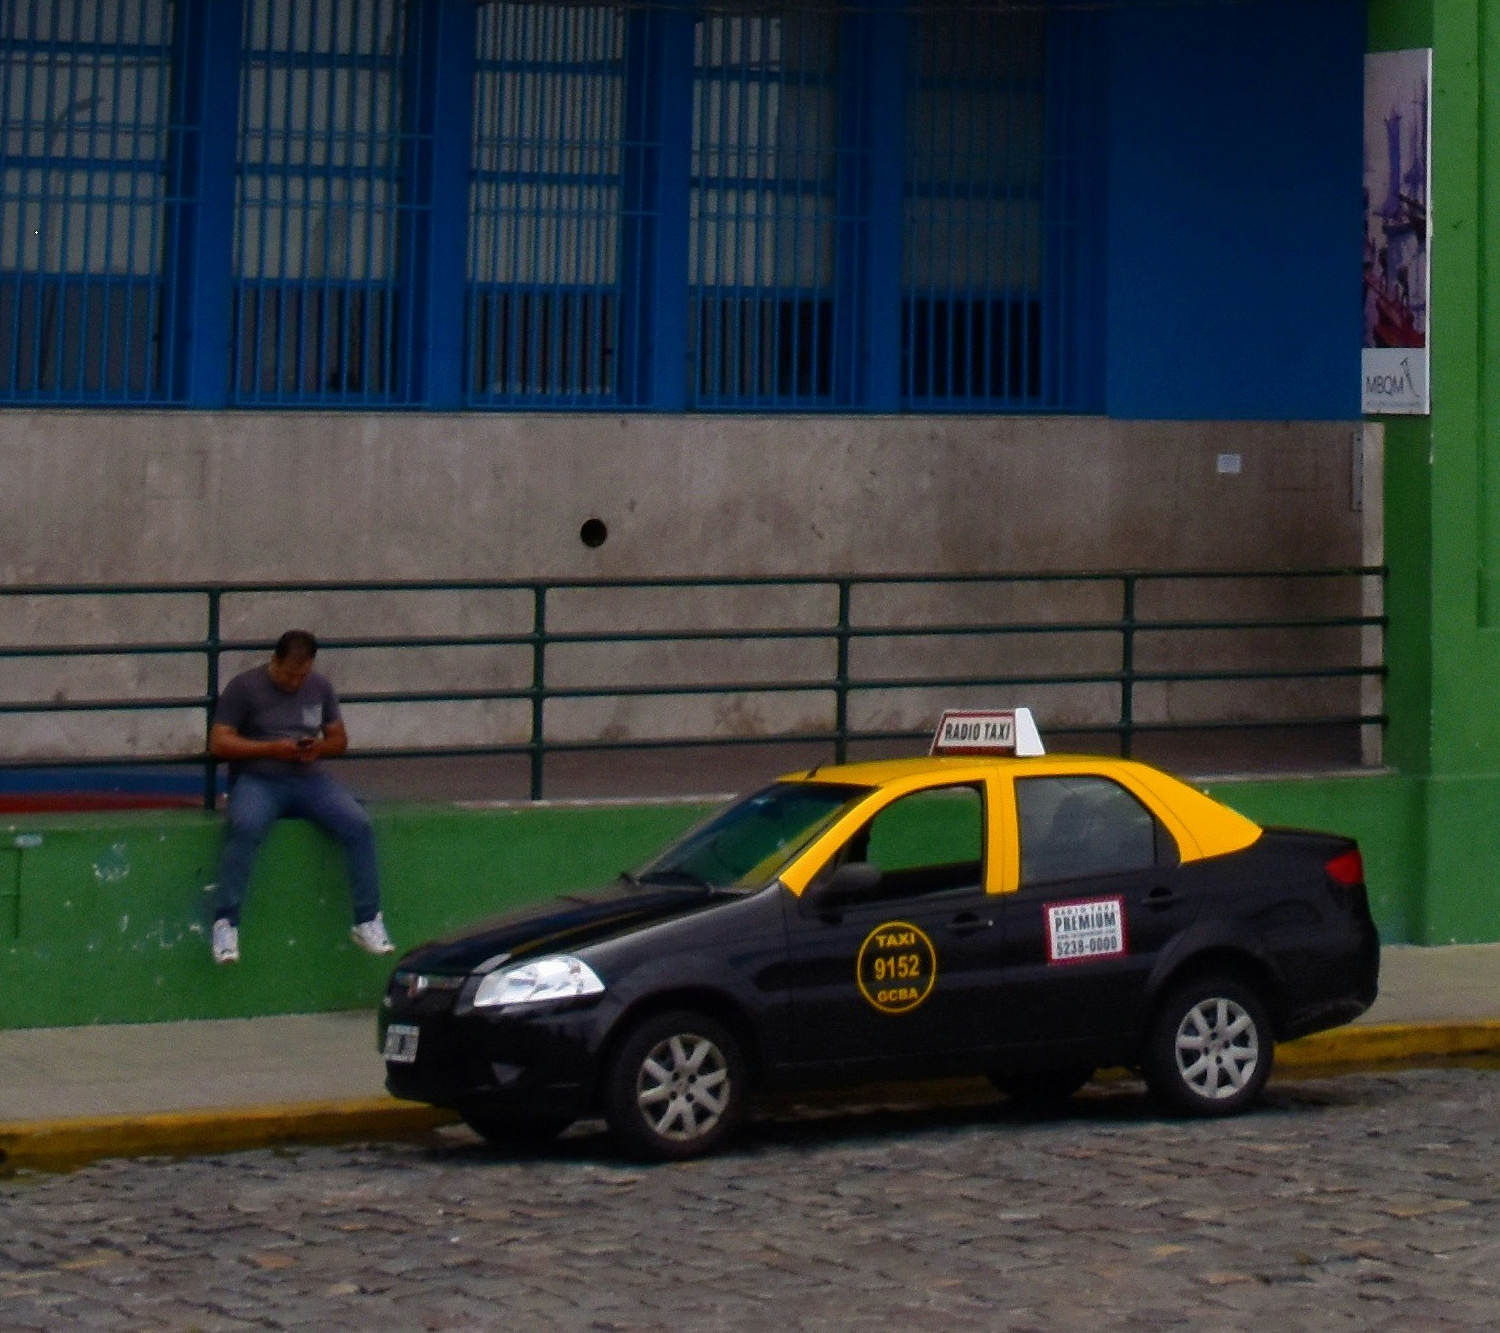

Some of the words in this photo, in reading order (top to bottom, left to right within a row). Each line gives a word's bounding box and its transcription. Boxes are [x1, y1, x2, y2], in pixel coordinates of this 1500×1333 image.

[945, 723, 981, 741] RADIO
[984, 723, 1011, 741] TAXI
[1055, 911, 1116, 933] PREMIUM
[876, 932, 916, 948] TAXI
[874, 954, 920, 981] 9152
[877, 987, 919, 1002] GCBA
